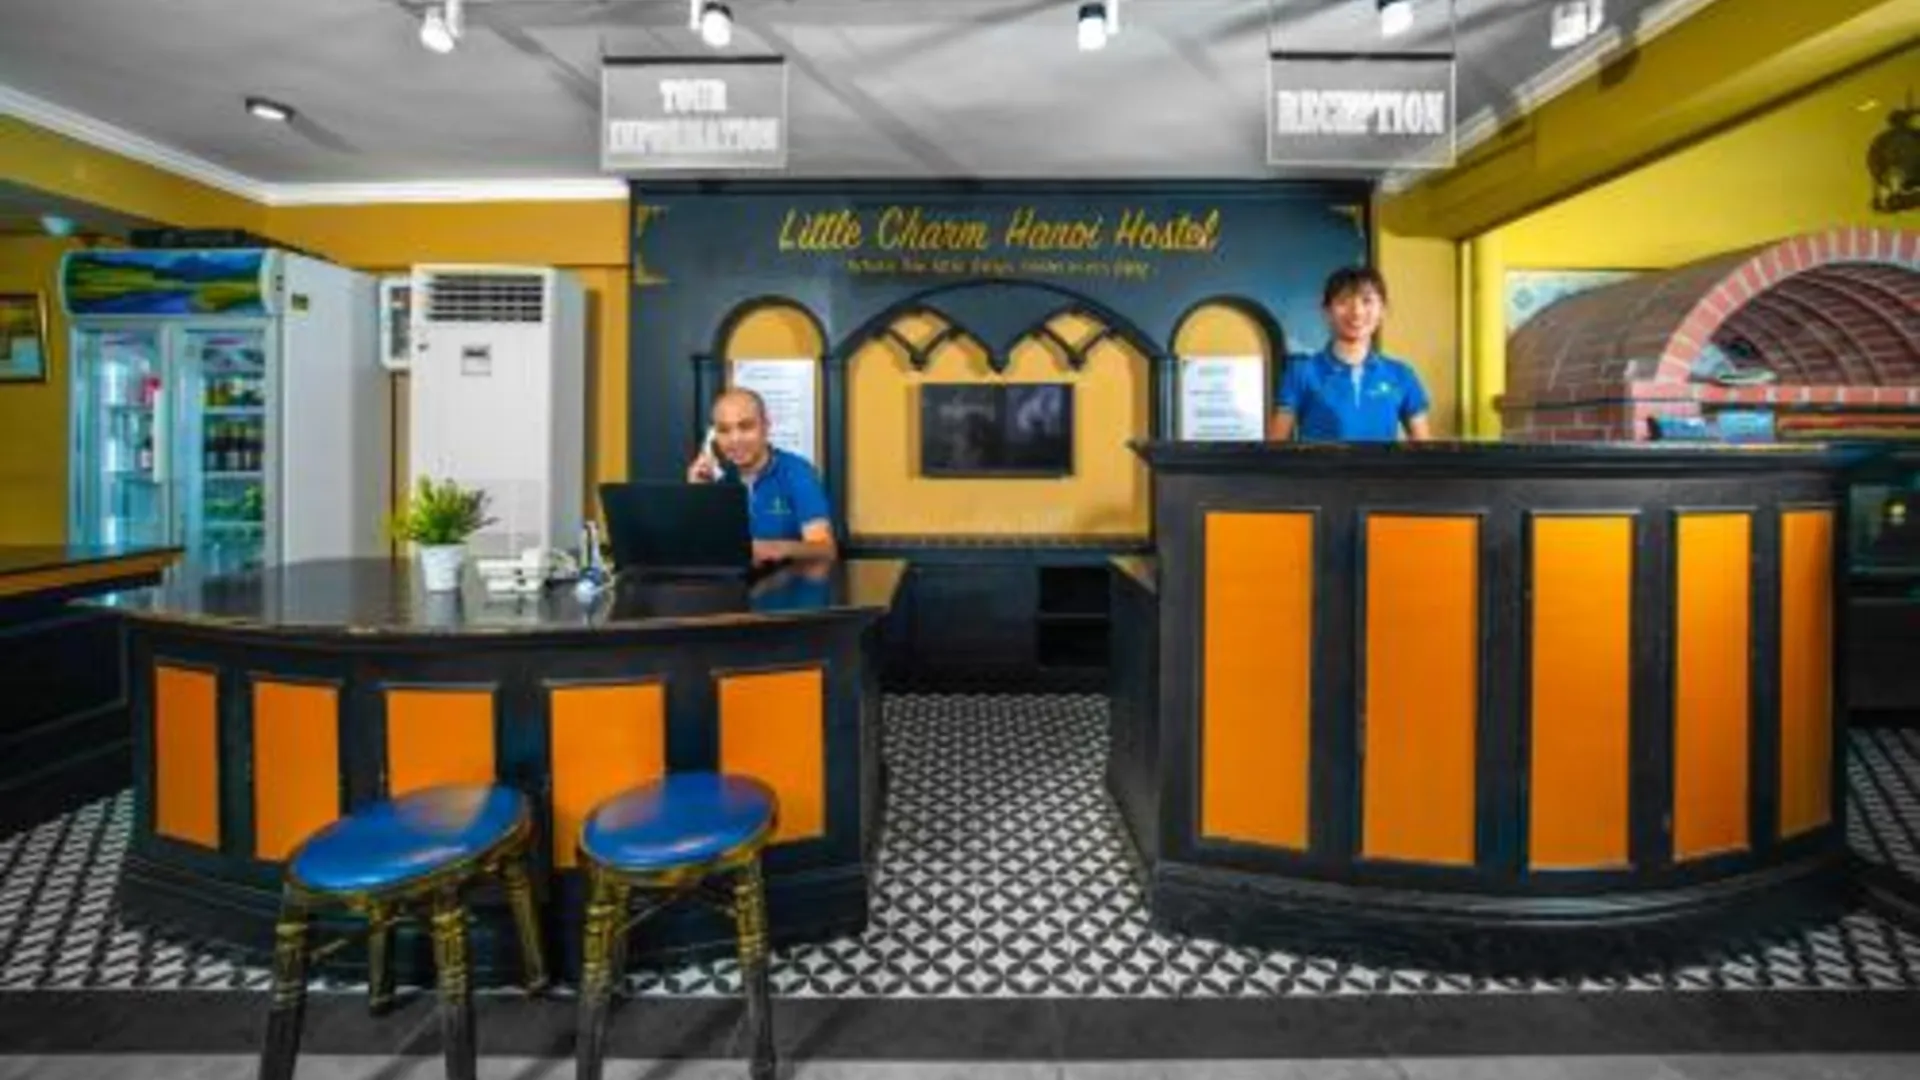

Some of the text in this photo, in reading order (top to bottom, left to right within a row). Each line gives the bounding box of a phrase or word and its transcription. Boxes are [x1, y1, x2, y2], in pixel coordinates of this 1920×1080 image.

[660, 78, 727, 113] TOUR
[1277, 89, 1446, 134] RECEPTION
[779, 205, 1220, 252] Little Charm Hanoi Hostel
